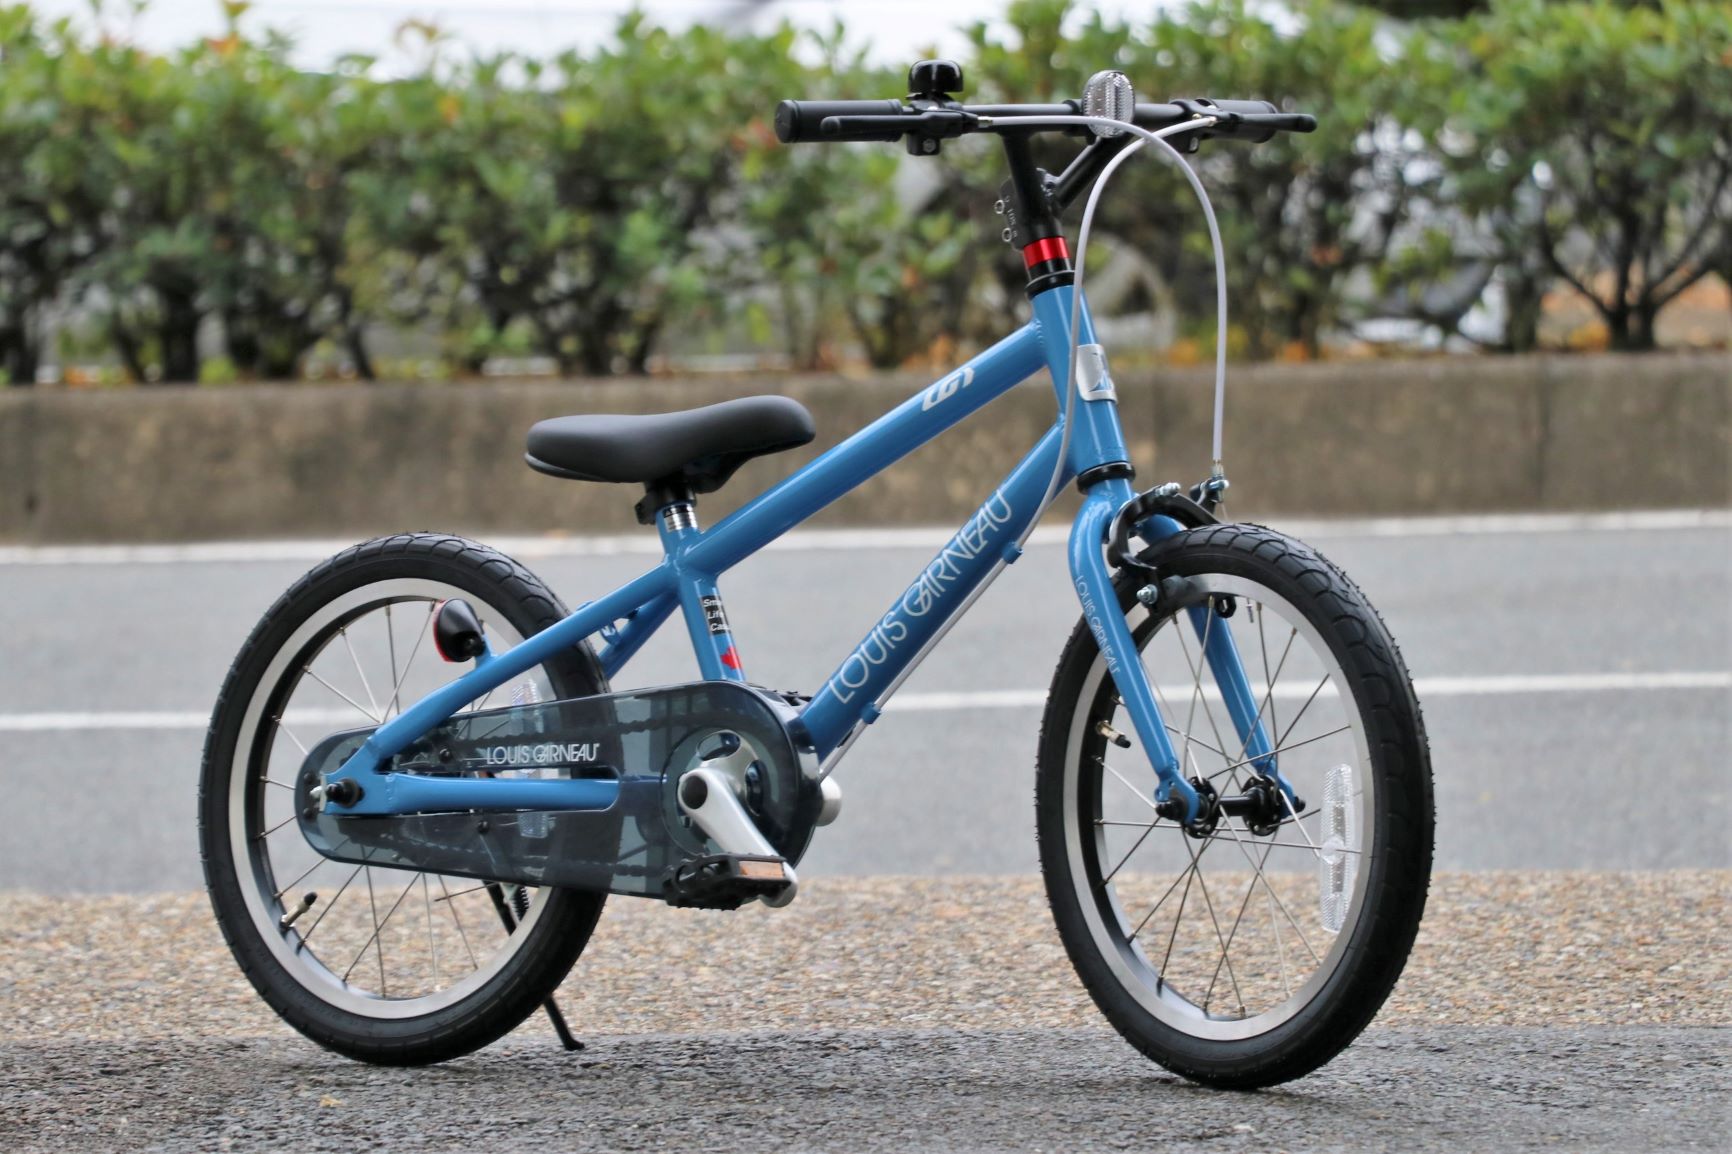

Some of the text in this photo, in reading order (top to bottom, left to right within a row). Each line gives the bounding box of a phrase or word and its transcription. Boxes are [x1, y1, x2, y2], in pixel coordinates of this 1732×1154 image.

[829, 489, 1012, 704] LOUIS GARNEAU
[1076, 575, 1121, 674] LOUIS GARNEAU
[487, 743, 599, 764] LOUIS GARNEAU
